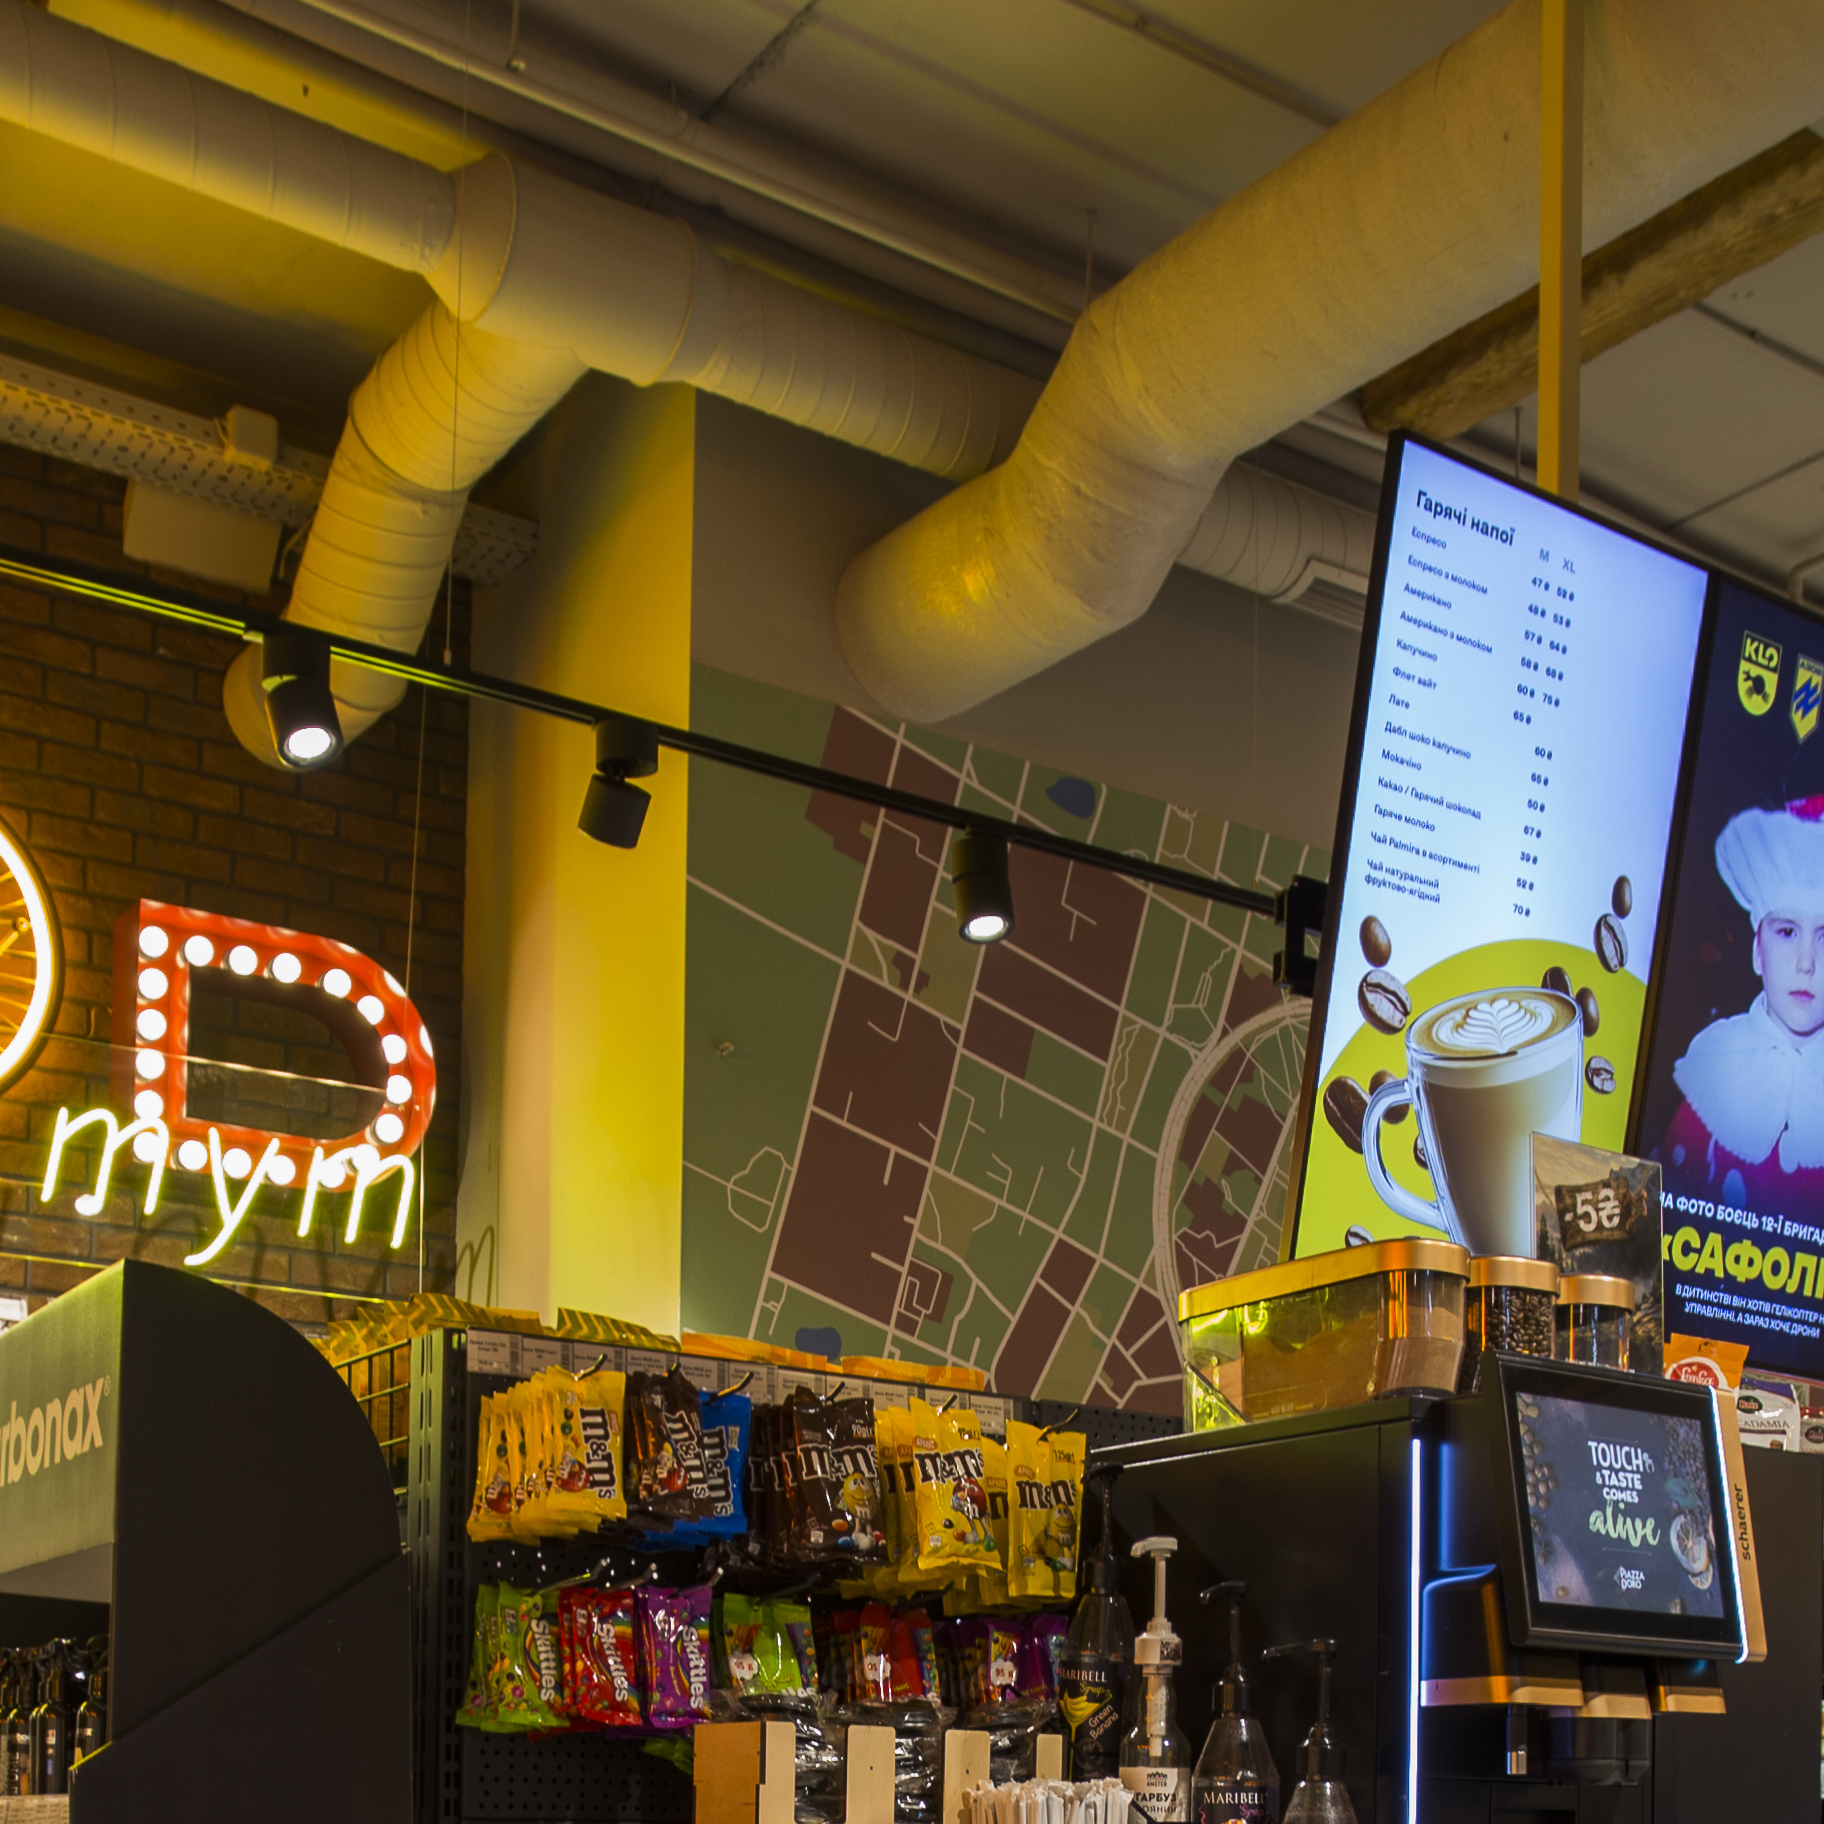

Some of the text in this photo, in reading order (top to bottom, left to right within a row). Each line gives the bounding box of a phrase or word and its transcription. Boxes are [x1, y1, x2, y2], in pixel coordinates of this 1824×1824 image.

[1416, 489, 1516, 547] Гарячі напої
[1411, 526, 1447, 549] Еспресо
[1407, 554, 1443, 577] Еспресо
[1451, 574, 1489, 596] молоком
[1562, 557, 1576, 574] XL
[1403, 582, 1452, 610] Американо
[1399, 610, 1449, 637] Американо
[1456, 633, 1493, 655] молоком
[1396, 638, 1438, 662] Капучино
[1392, 666, 1438, 691] Флет вайт
[1388, 693, 1410, 709] Лате
[1513, 710, 1525, 723] 65
[1384, 721, 1472, 760] Дабл шоко капучино
[1534, 746, 1546, 758] 60
[1381, 748, 1422, 771] Мокачіно
[1378, 776, 1403, 794] Какао
[1410, 788, 1445, 808] Гарячий
[1445, 799, 1482, 820] шоколад
[1374, 804, 1436, 832] Гаряче молоко
[1370, 831, 1388, 845] Чай
[1388, 836, 1421, 856] Palmira
[1428, 851, 1481, 875] асортименті
[1367, 858, 1440, 889] Чай натуральний
[1364, 873, 1441, 904] фруктово-ягідний
[1676, 1196, 1714, 1218] ФОТО
[1716, 1205, 1759, 1229] БОЄЦЬ
[1682, 1284, 1732, 1306] ДИТИНСТВІ
[1746, 1297, 1771, 1314] ХОТІВ
[1743, 1313, 1770, 1329] ЗАРАЗ
[1770, 1317, 1791, 1334] ХОЧЕ
[1791, 1322, 1820, 1339] ДРОНИ
[1587, 1440, 1644, 1472] TOUCH
[1602, 1487, 1639, 1503] COMES
[1588, 1500, 1662, 1548] alive
[1733, 1482, 1752, 1562] schaerer
[1619, 1565, 1646, 1582] PIAZZA
[530, 1618, 559, 1702] Skittles
[597, 1622, 630, 1703] Skittles
[681, 1624, 708, 1710] Skittles
[1087, 1703, 1114, 1728] Green
[1089, 1711, 1120, 1740] Banana
[1203, 1791, 1266, 1805] MARIBELL
